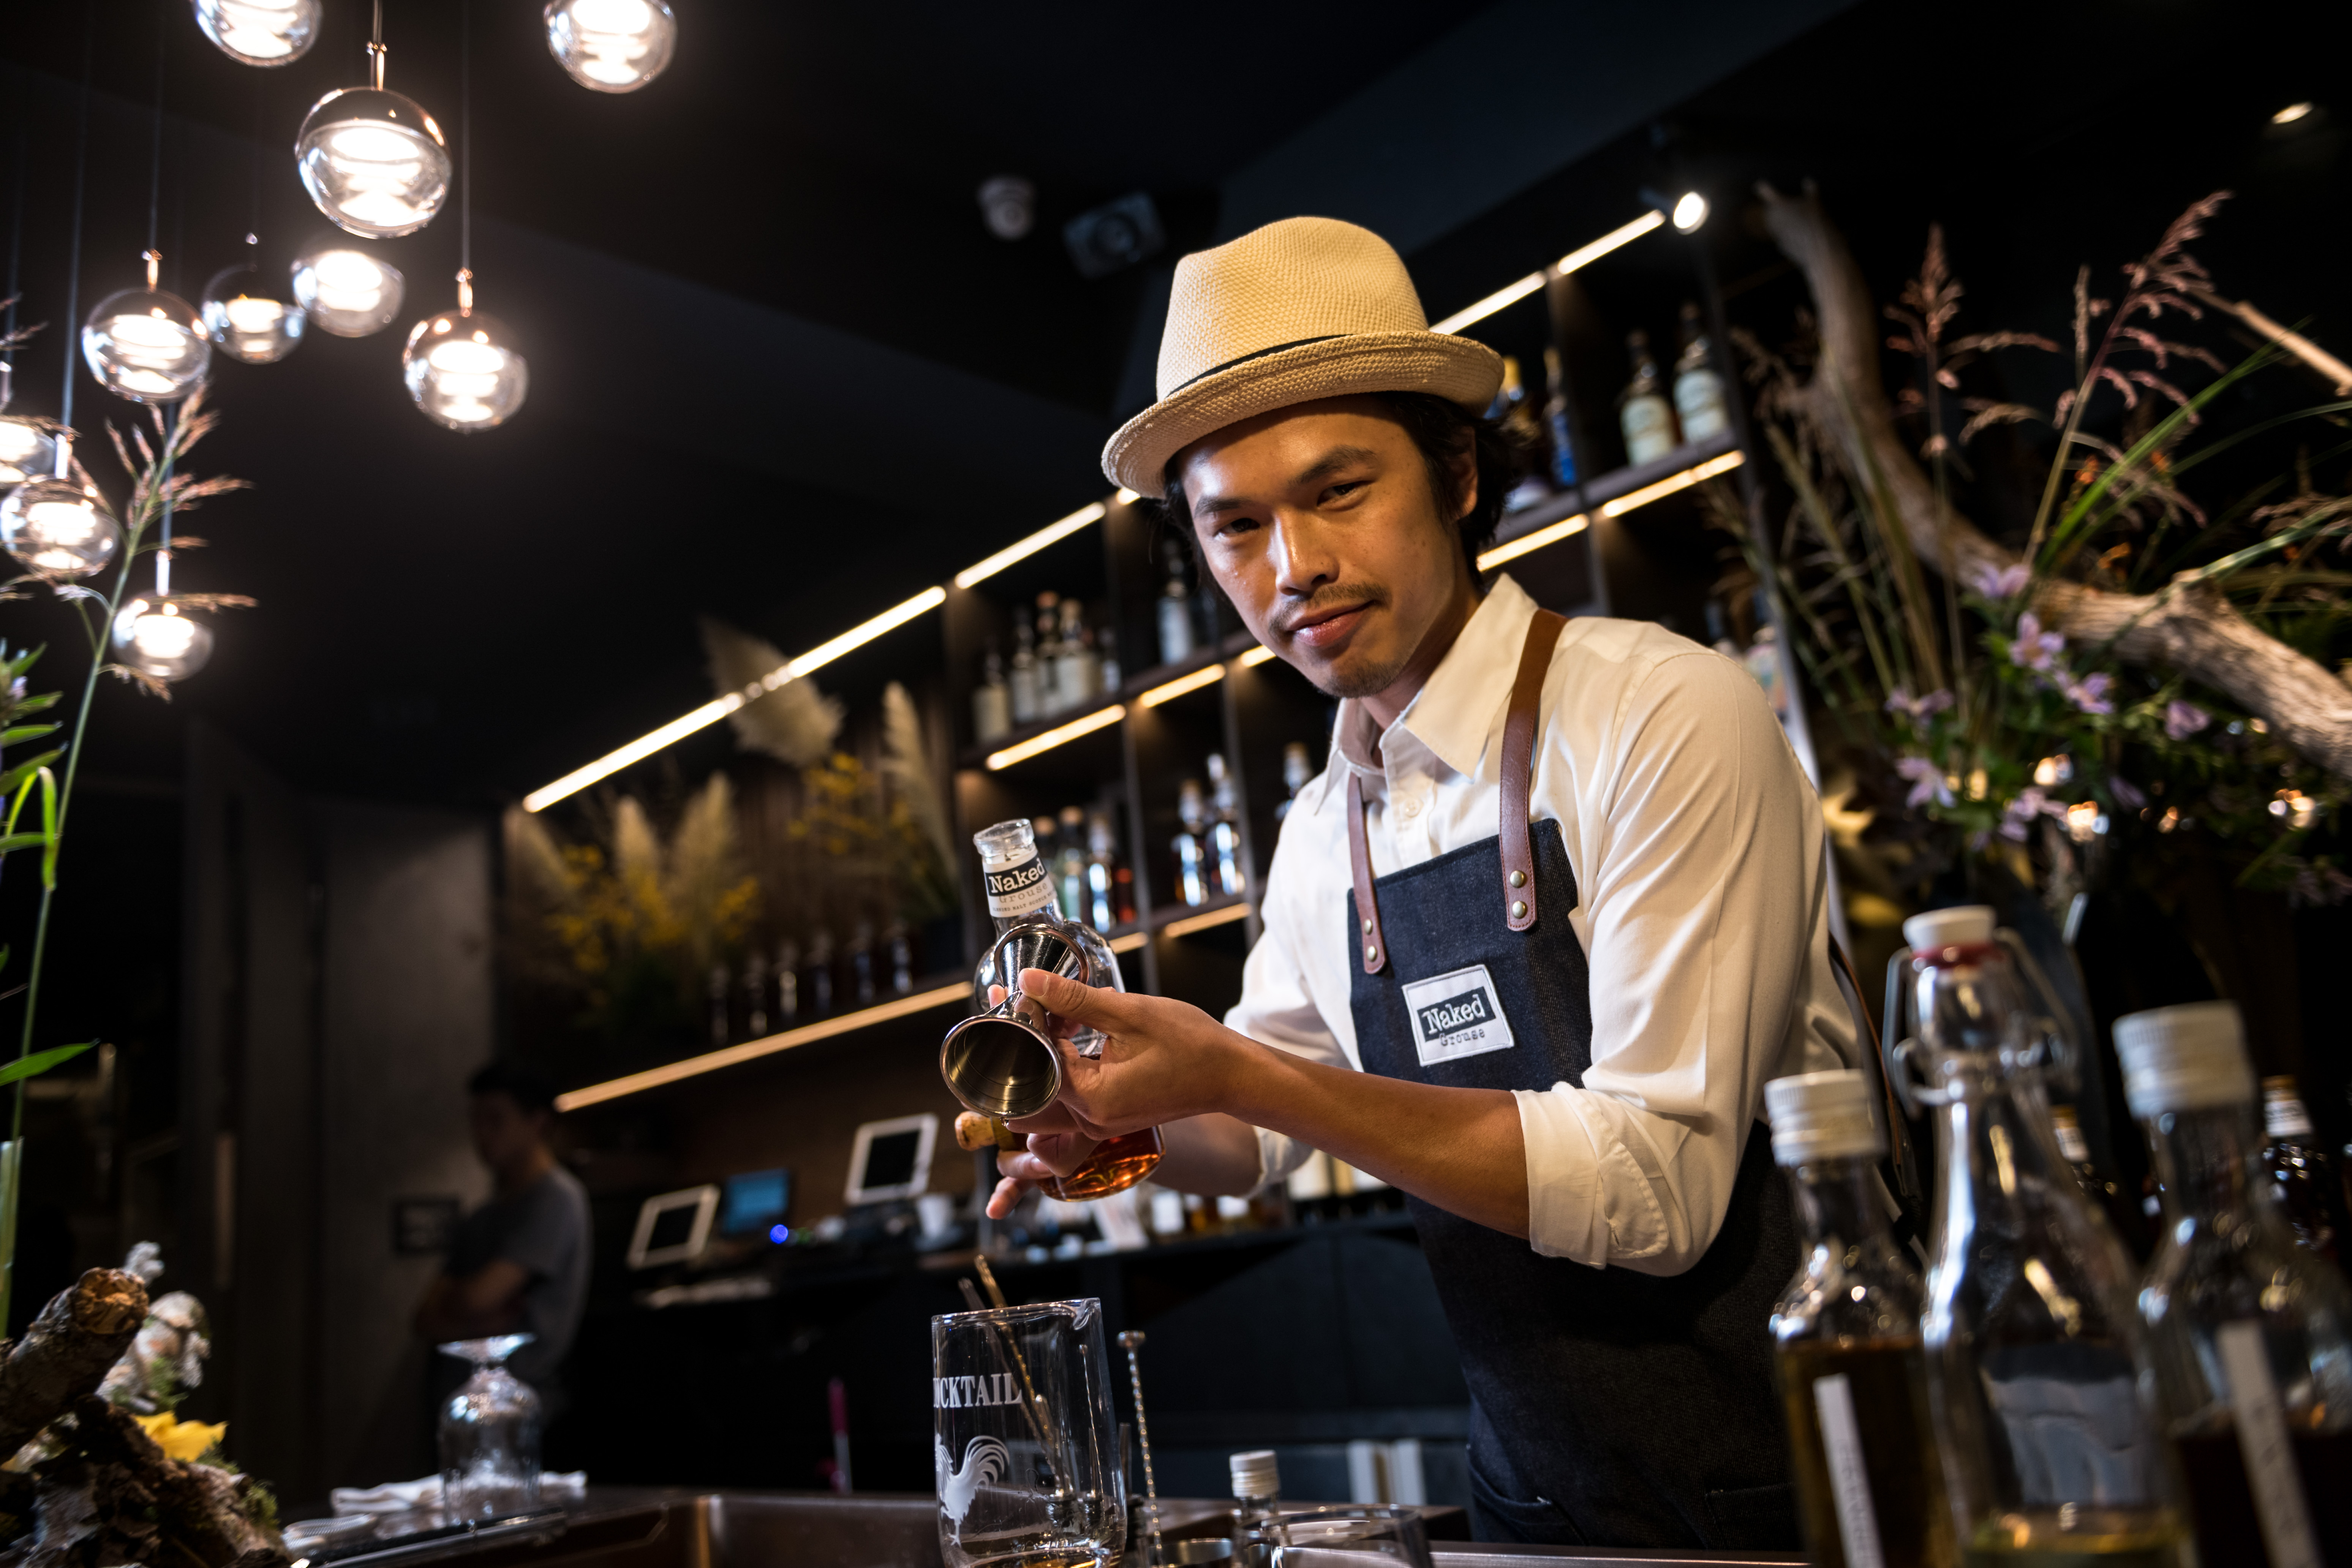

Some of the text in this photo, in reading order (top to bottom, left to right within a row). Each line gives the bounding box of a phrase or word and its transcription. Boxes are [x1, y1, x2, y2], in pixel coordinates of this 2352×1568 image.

[989, 857, 1045, 893] Naked
[999, 883, 1048, 903] Grouse
[1422, 994, 1485, 1035] Naked
[1438, 1029, 1485, 1046] Grouse
